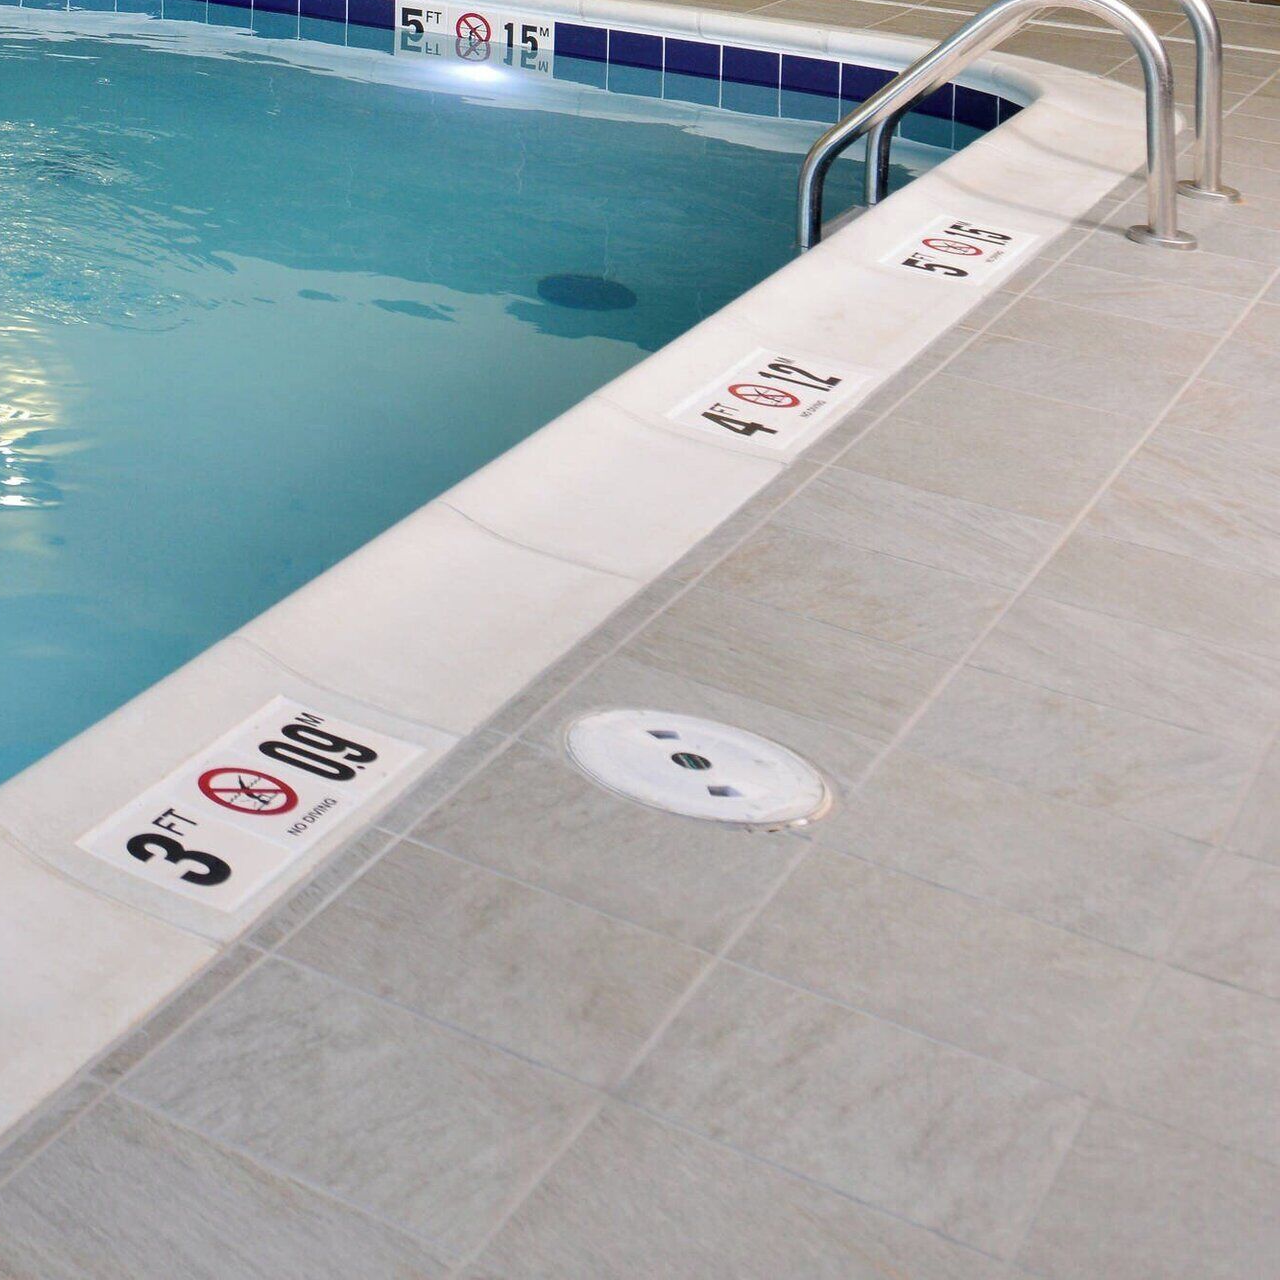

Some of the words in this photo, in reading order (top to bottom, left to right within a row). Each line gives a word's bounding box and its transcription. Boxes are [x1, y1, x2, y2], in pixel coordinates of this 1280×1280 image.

[401, 7, 425, 34] 5
[426, 10, 442, 24] FT
[504, 22, 539, 51] 15
[540, 27, 550, 38] M
[901, 256, 969, 278] 5
[709, 402, 740, 416] FT
[700, 411, 779, 437] 4
[294, 711, 326, 728] M
[151, 807, 198, 837] FT
[286, 822, 308, 837] NO
[301, 798, 338, 824] DIVING
[126, 832, 233, 887] 3
